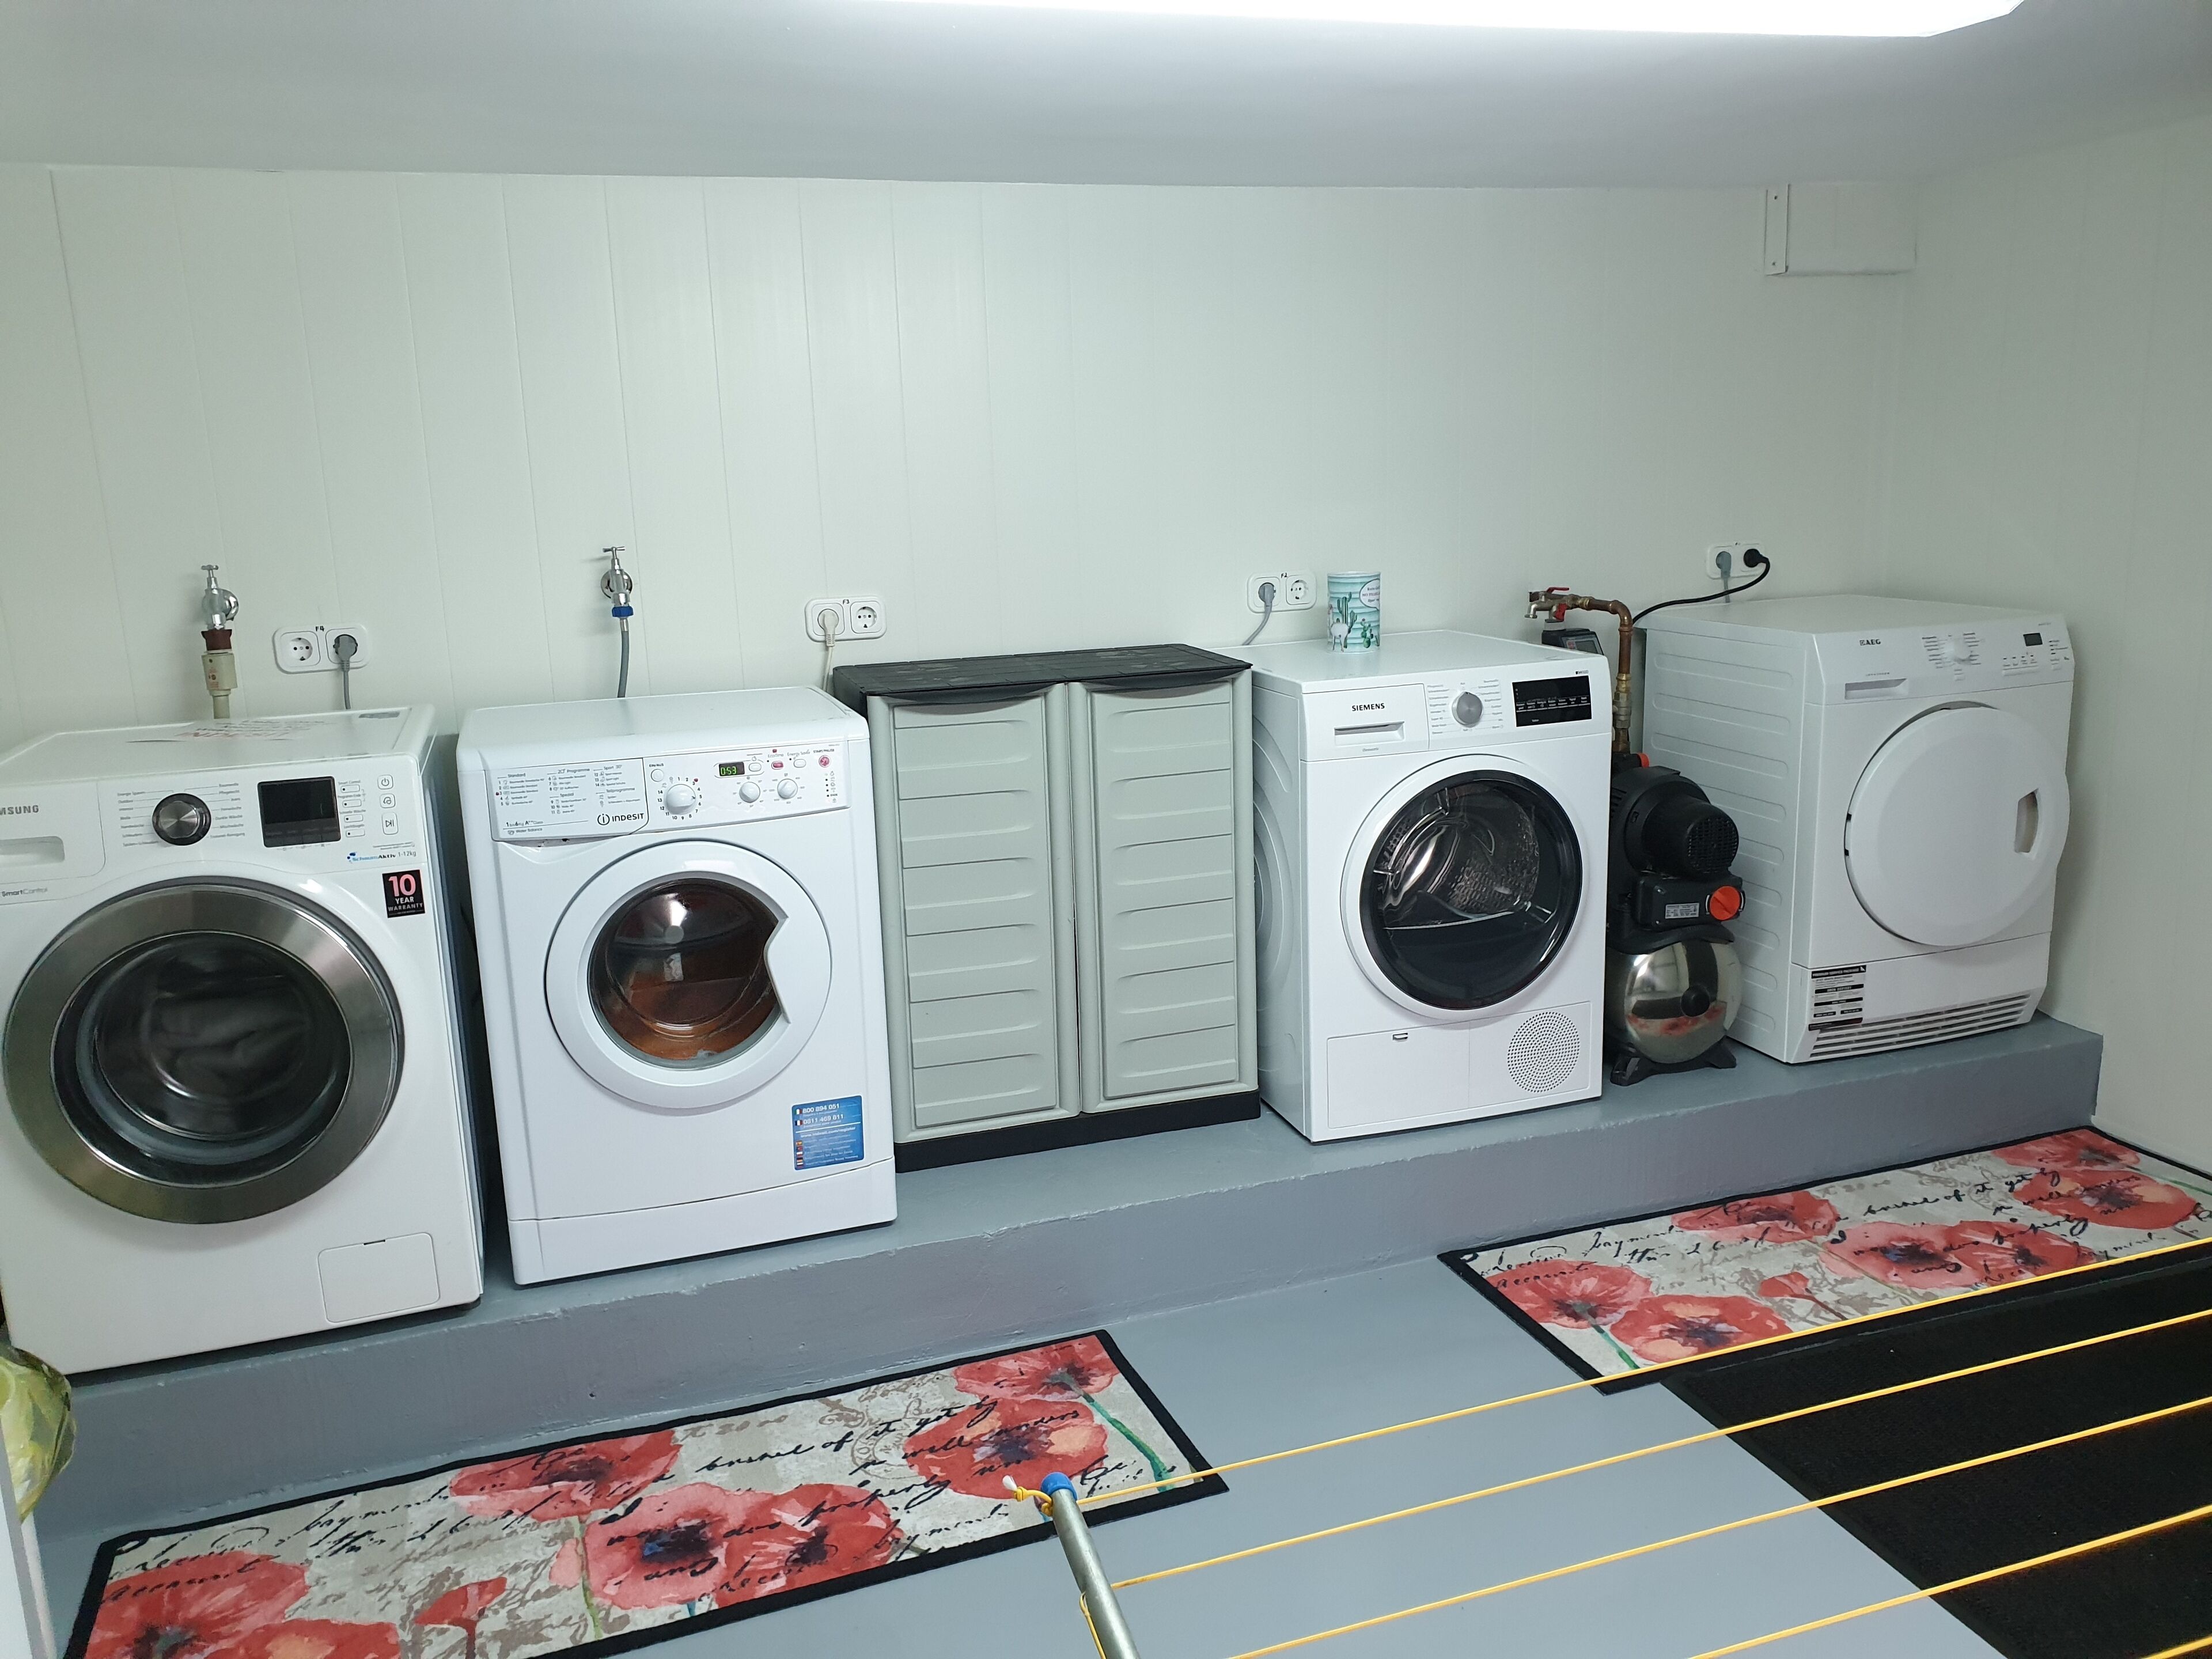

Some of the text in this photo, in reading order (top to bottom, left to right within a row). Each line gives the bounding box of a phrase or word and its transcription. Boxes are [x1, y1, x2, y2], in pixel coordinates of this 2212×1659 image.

[1351, 703, 1385, 711] SIEMENS
[720, 766, 737, 775] 0:53
[388, 873, 416, 897] 10
[395, 896, 414, 904] YEAR
[388, 903, 423, 912] WARRANTY
